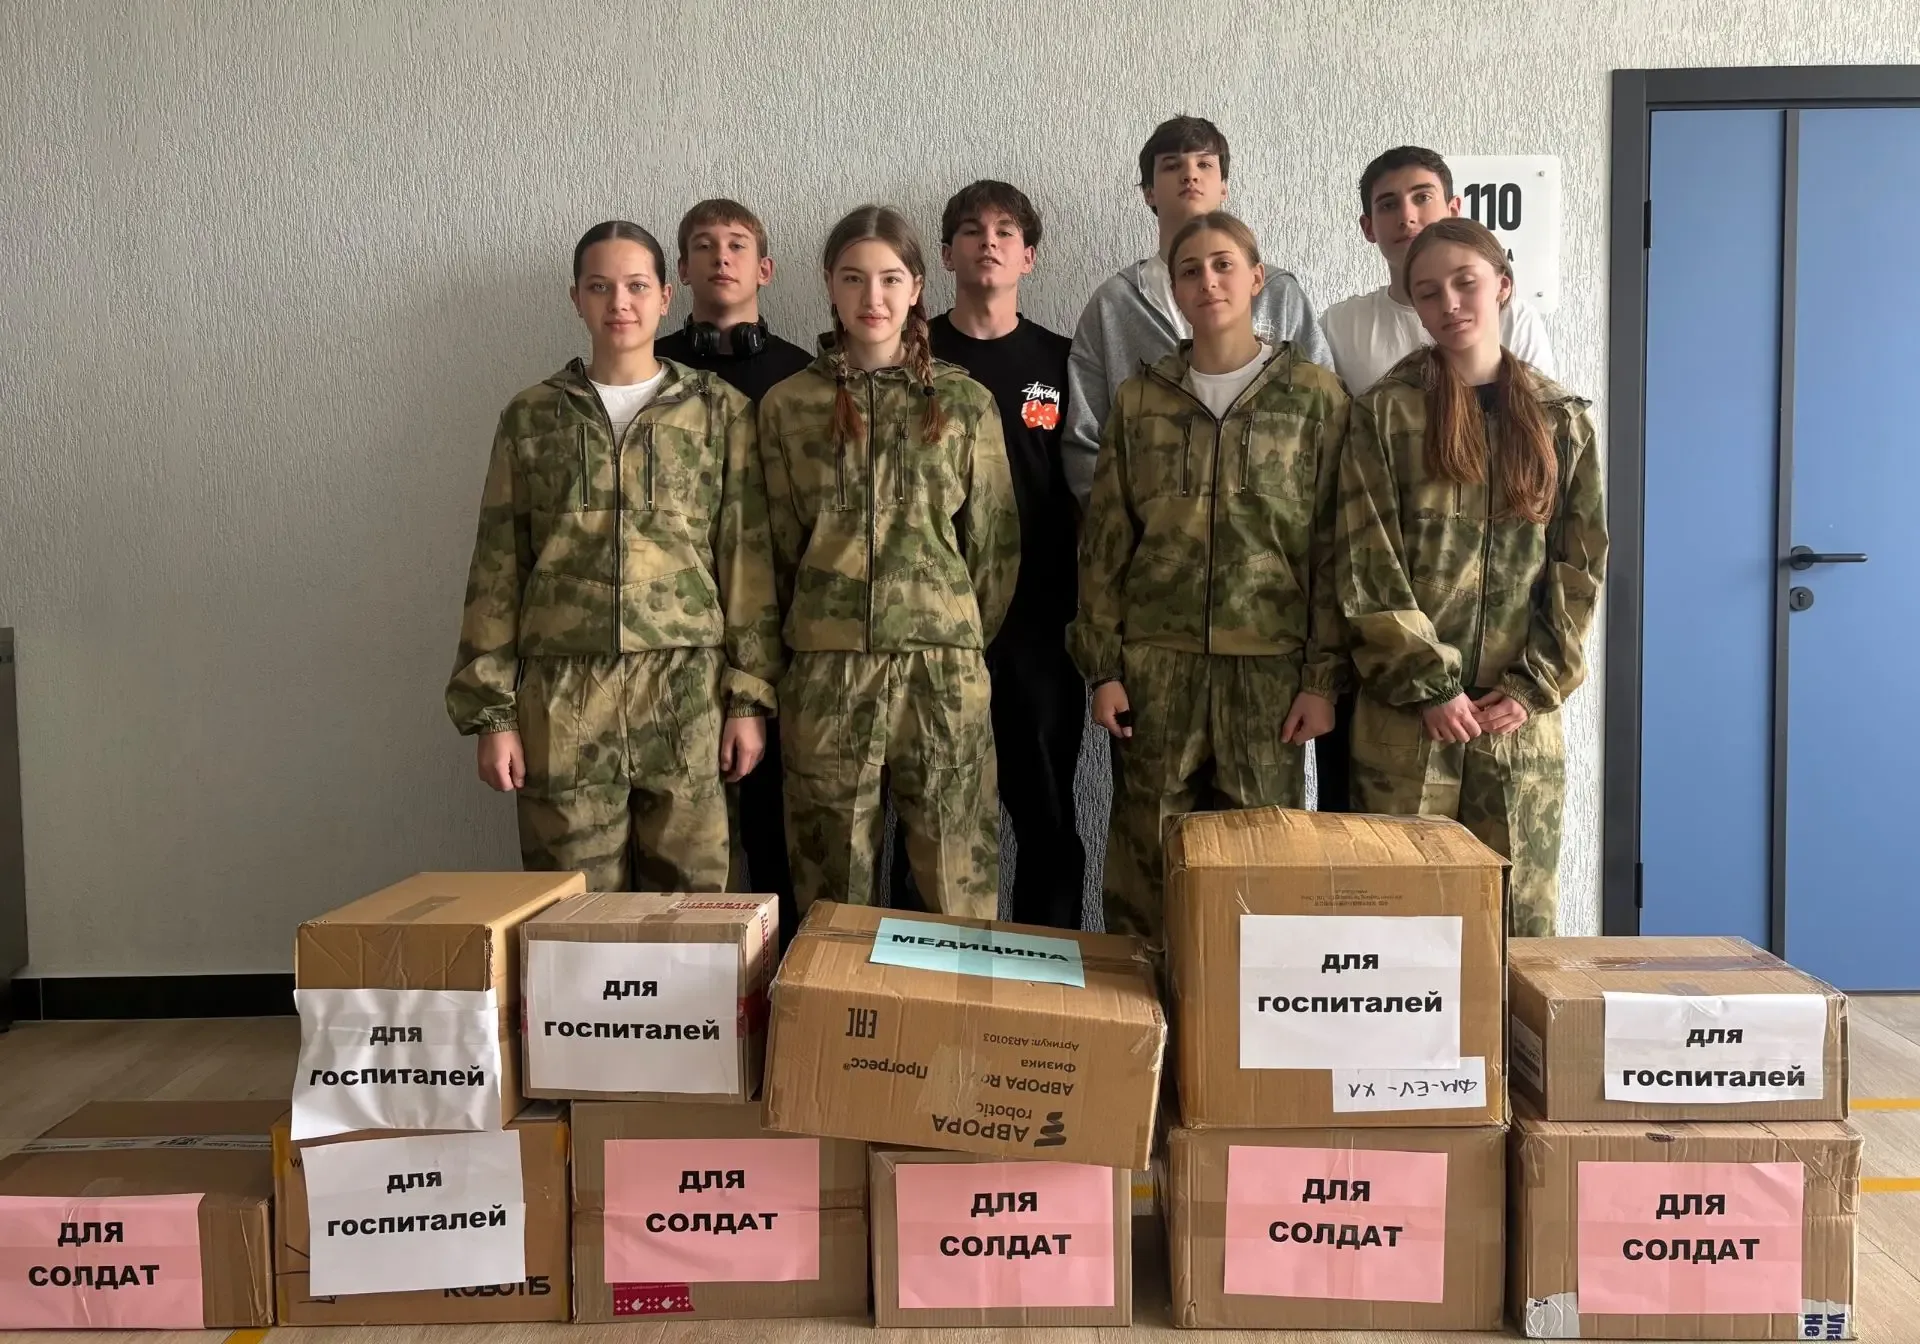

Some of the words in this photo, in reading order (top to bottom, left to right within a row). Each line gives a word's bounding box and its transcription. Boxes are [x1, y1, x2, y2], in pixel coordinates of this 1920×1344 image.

[1463, 183, 1522, 231] 110
[892, 932, 1070, 963] МЕДИЦИНА
[1321, 954, 1379, 974] для
[602, 980, 658, 1000] для
[1258, 990, 1442, 1014] госпиталей
[369, 1025, 423, 1046] для
[544, 1019, 720, 1041] госпиталей
[1686, 1028, 1743, 1048] для
[1031, 1038, 1079, 1052] Артикул:
[309, 1064, 485, 1087] госпиталей
[1021, 1059, 1076, 1073] Физика
[1623, 1065, 1805, 1087] госпиталей
[1006, 1076, 1074, 1096] АВРОРА
[932, 1114, 1030, 1142] АВРОРА
[386, 1171, 442, 1194] для
[678, 1169, 745, 1194] ДЛЯ
[1302, 1178, 1371, 1205] ДЛЯ
[970, 1191, 1038, 1218] ДЛЯ
[1655, 1193, 1726, 1220] ДЛЯ
[327, 1203, 506, 1237] госпиталей
[645, 1211, 779, 1235] СОЛДАТ
[57, 1221, 124, 1248] ДЛЯ
[1268, 1221, 1403, 1251] СОЛДАТ
[939, 1234, 1072, 1260] СОЛДАТ
[1622, 1237, 1760, 1265] СОЛДАТ
[28, 1264, 160, 1291] СОЛДАТ
